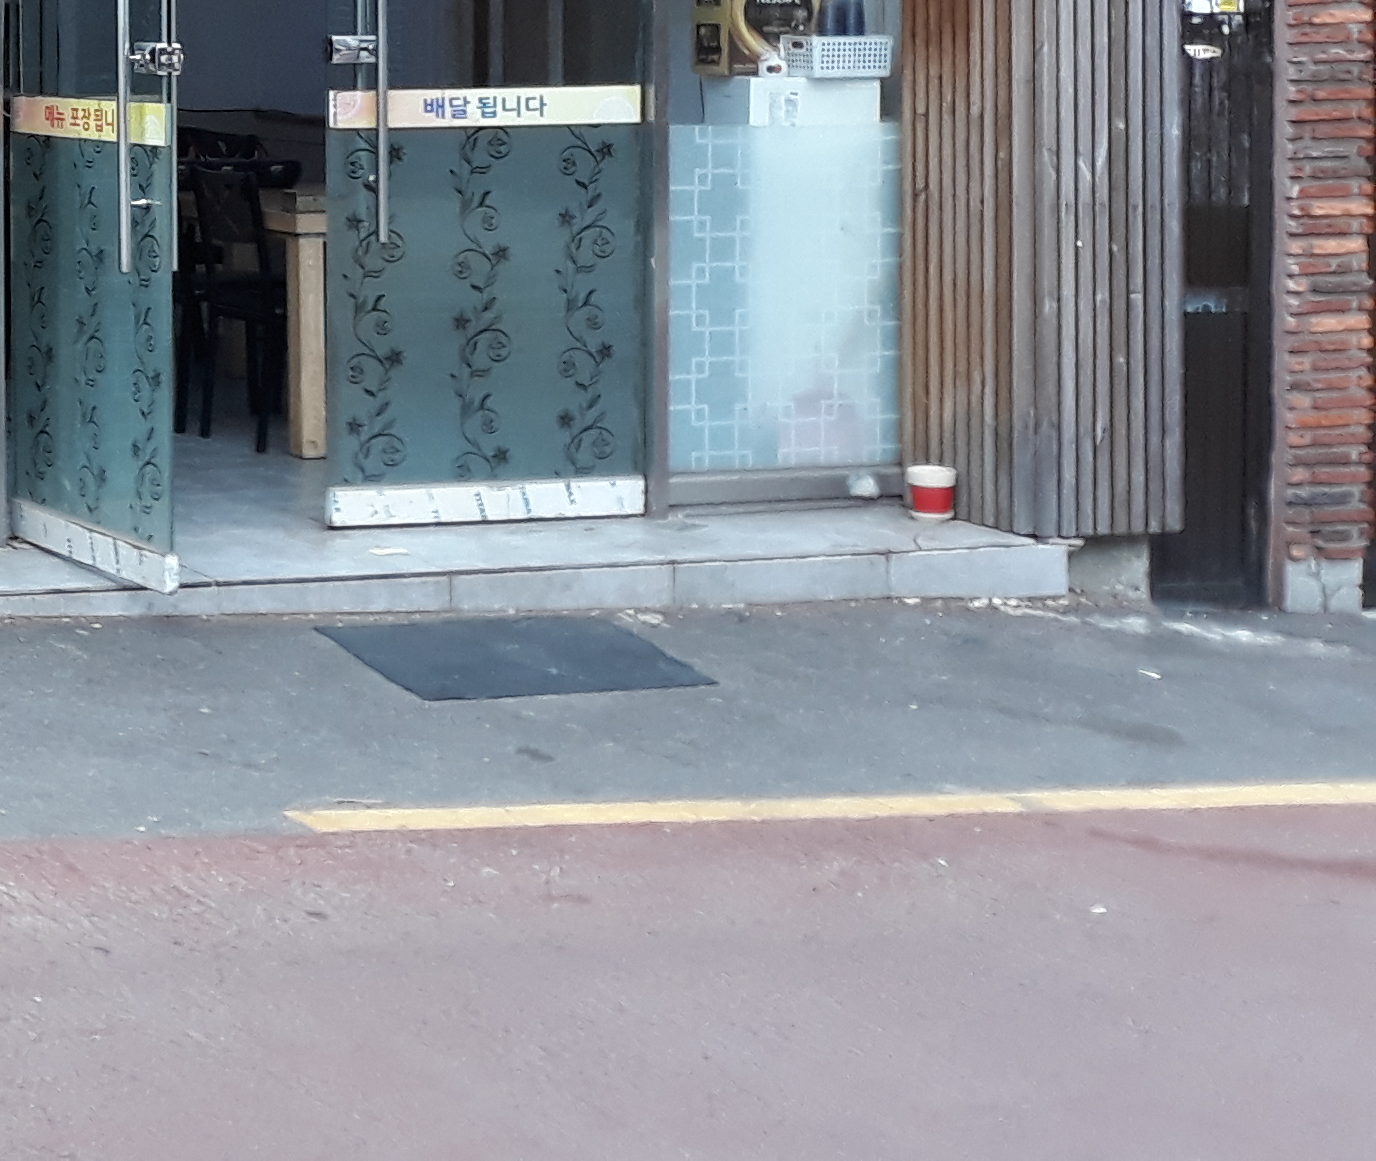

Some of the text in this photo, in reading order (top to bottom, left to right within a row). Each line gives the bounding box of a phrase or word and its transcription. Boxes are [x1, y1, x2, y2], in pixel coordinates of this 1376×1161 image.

[69, 106, 92, 132] 포장
[92, 108, 116, 134] 됩니
[423, 94, 548, 120] 배달 됩니다
